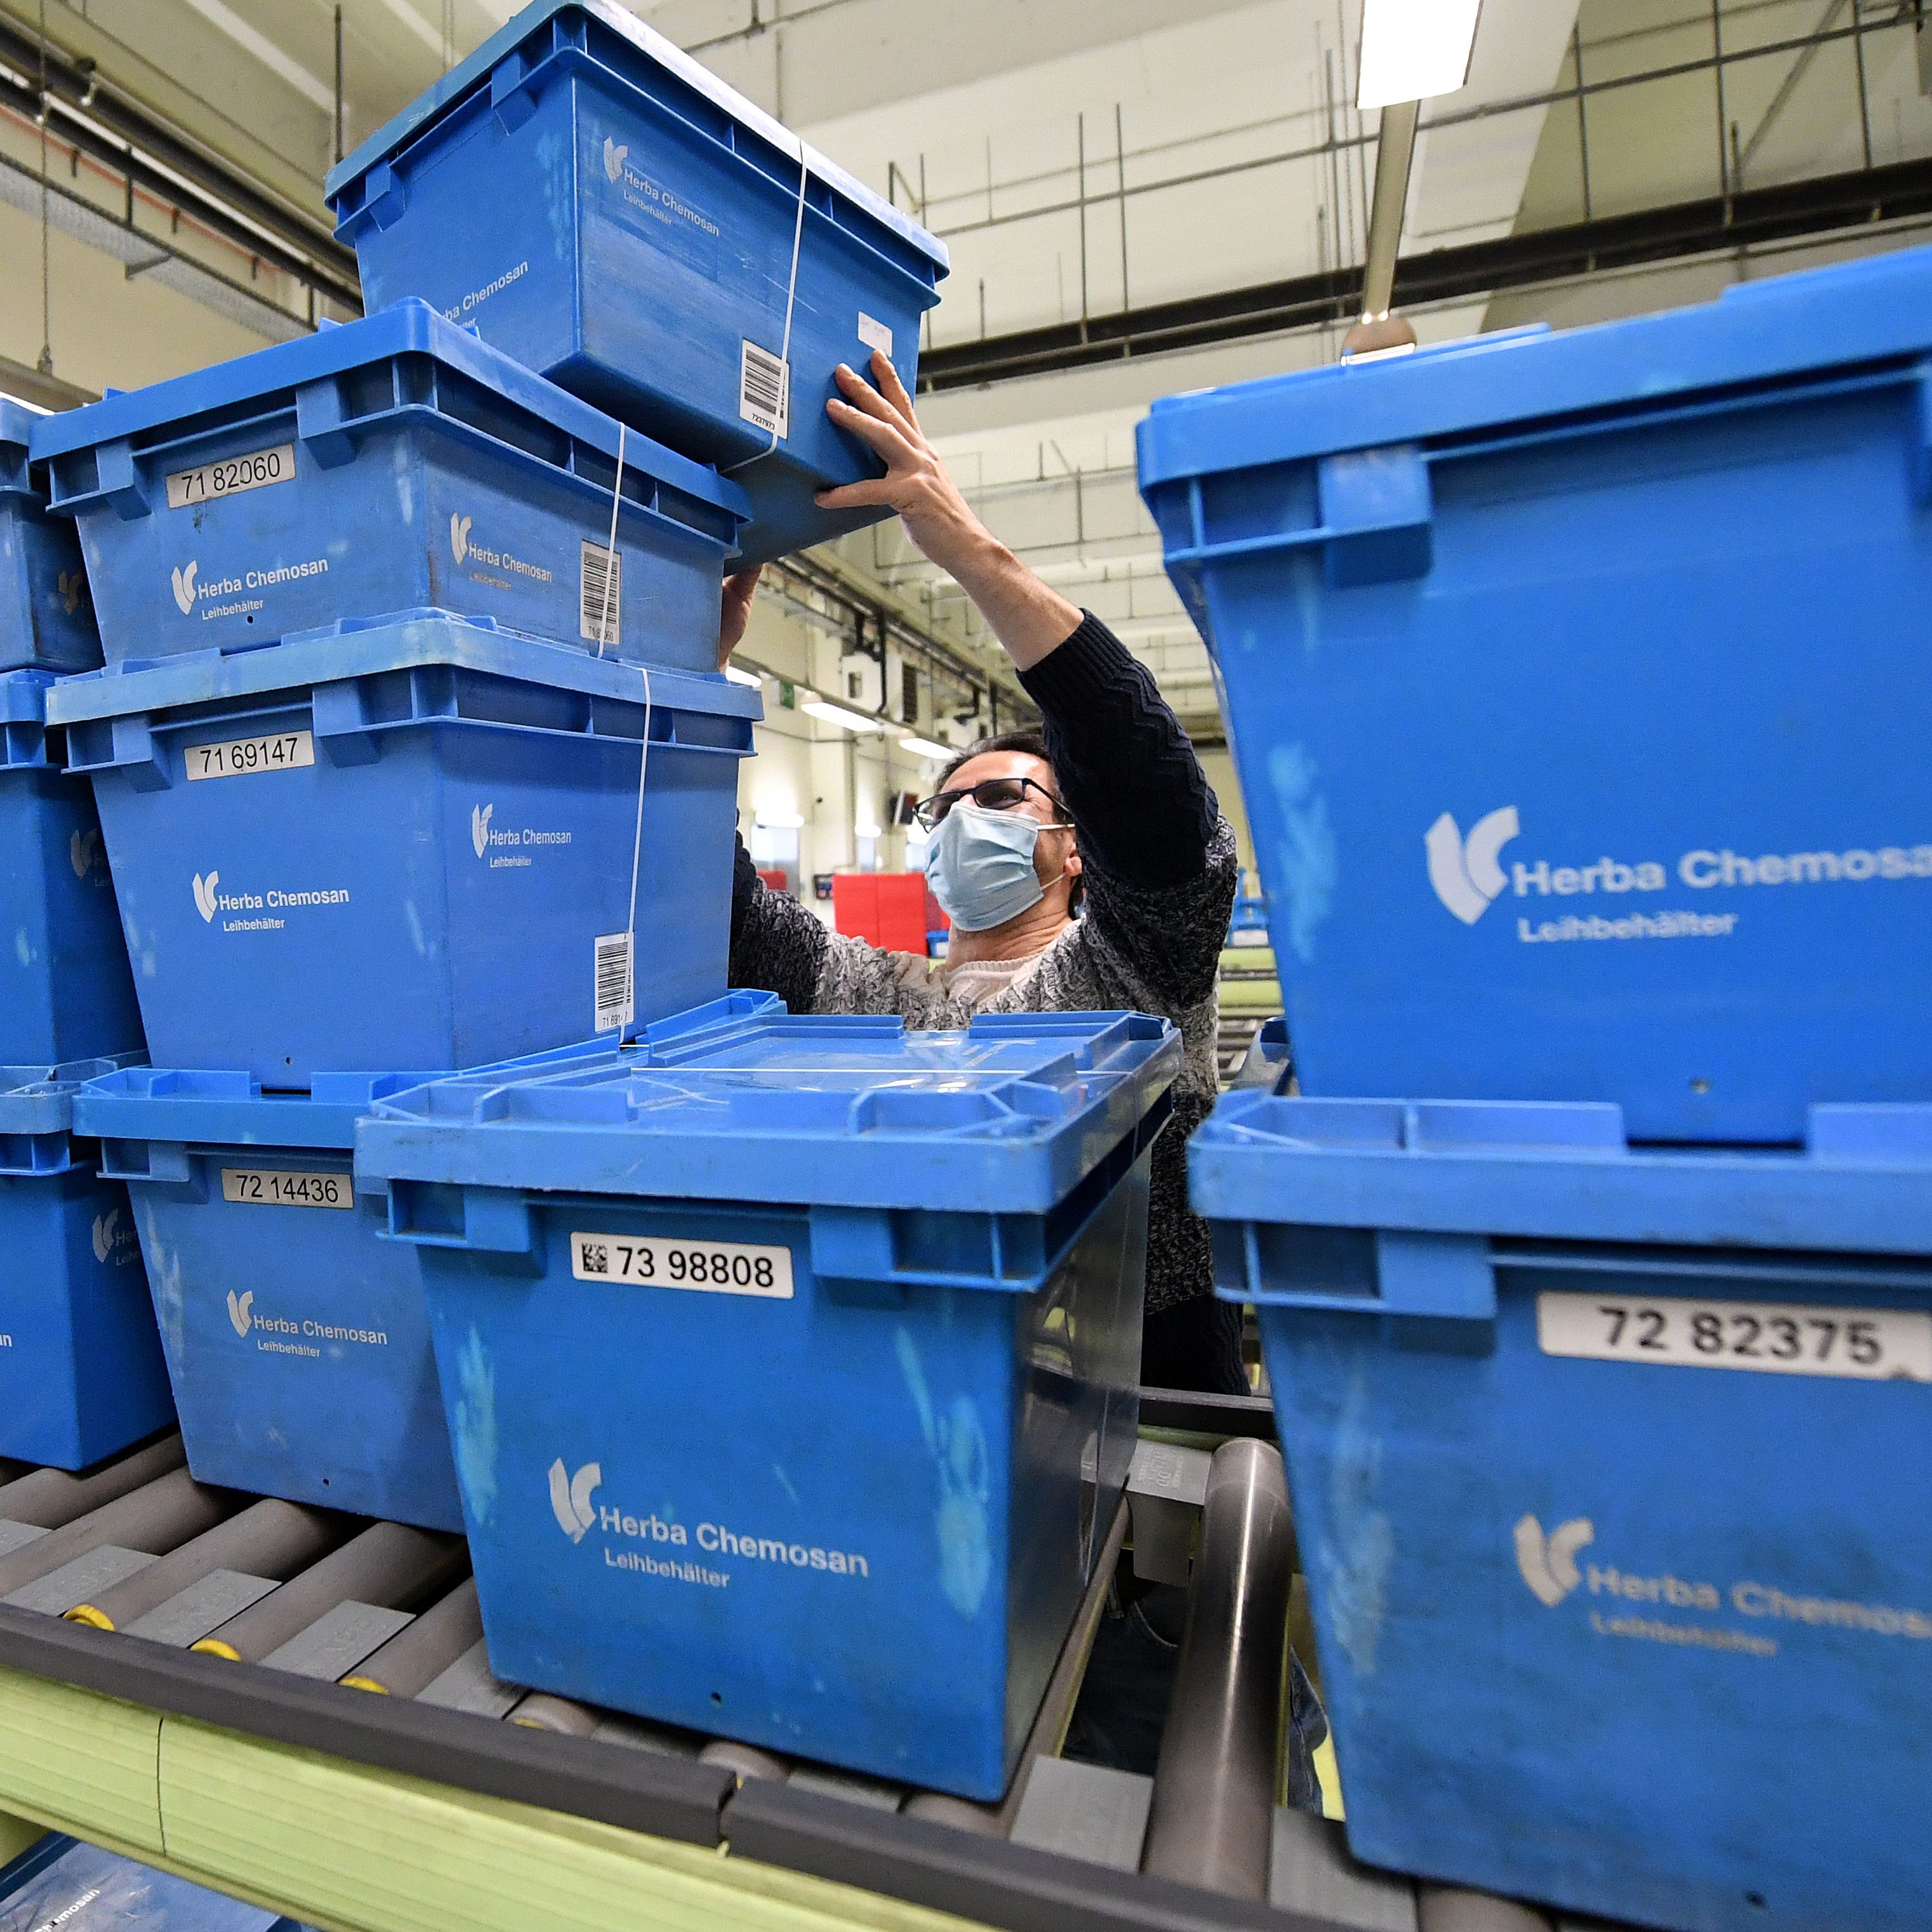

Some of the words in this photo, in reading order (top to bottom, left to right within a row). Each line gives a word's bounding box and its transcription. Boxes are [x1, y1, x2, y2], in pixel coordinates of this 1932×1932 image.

[624, 168, 659, 200] Herba
[662, 193, 720, 237] Chemosan
[463, 261, 528, 310] Chemosan
[182, 473, 205, 499] 71
[213, 453, 281, 491] 82060
[197, 578, 242, 600] Herba
[246, 559, 329, 589] Chemosan
[468, 542, 500, 566] Herba
[502, 553, 552, 582] Chemosan
[201, 600, 264, 621] Leihbehälter
[200, 748, 223, 773] 71
[231, 737, 298, 769] 69147
[489, 830, 520, 846] Herba
[523, 829, 571, 845] Chemosan
[1511, 856, 1667, 897] Herba
[218, 894, 263, 911] Herba
[267, 889, 350, 908] Chemosan
[223, 918, 285, 932] Leihbehälter
[236, 1175, 263, 1198] 72
[270, 1176, 339, 1203] 14436
[616, 1247, 656, 1278] 73
[668, 1250, 774, 1288] 98808
[253, 1314, 299, 1334] Herba
[303, 1321, 388, 1345] Chemosan
[257, 1339, 321, 1358] Leihbehälter
[1599, 1305, 1667, 1351] 72
[1692, 1311, 1884, 1365] 82375
[600, 1505, 688, 1546] Herba
[696, 1521, 869, 1578] Chemosan
[604, 1547, 731, 1588] Leihbehälter
[1588, 1563, 1721, 1610] Herba
